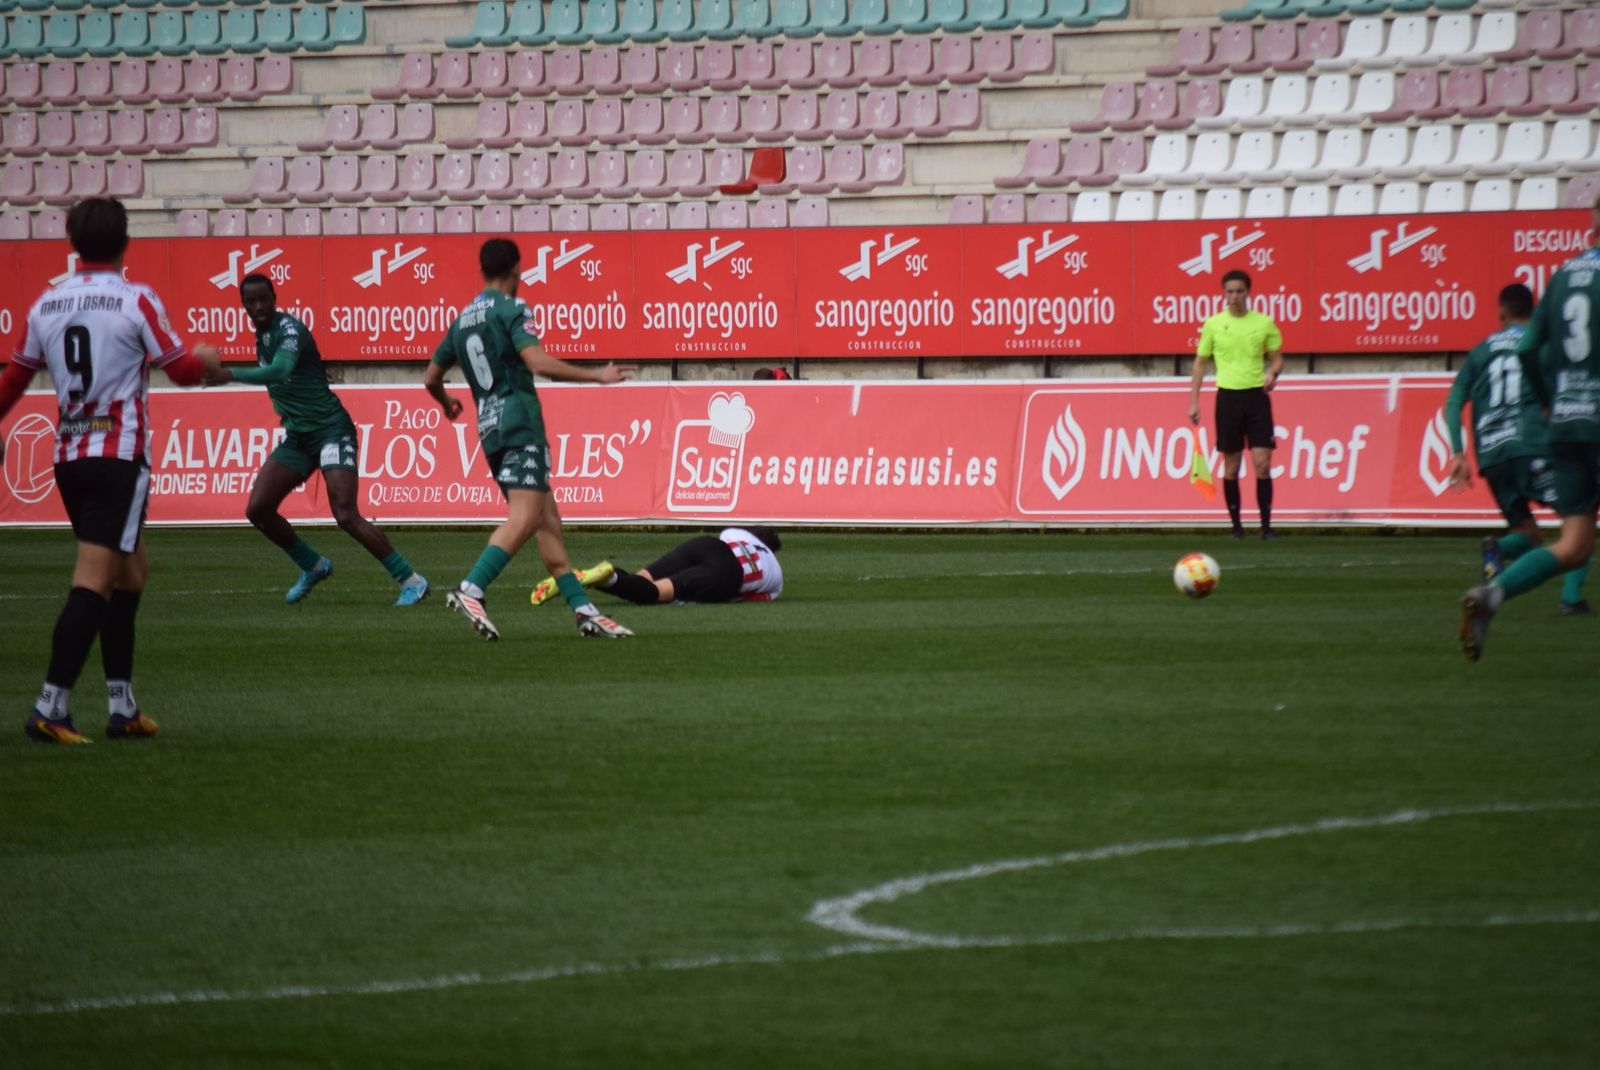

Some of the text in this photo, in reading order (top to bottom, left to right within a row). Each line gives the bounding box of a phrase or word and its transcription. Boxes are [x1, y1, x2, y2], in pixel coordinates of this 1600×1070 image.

[1064, 250, 1088, 275] sgc
[1249, 246, 1274, 271] sgc
[1420, 243, 1447, 268] sgc
[1513, 228, 1595, 253] DESGUAC
[270, 262, 291, 286] sgc
[413, 261, 435, 285] sgc
[580, 258, 602, 282] sgc
[730, 256, 753, 279] sgc
[905, 252, 928, 277] sgc
[187, 298, 315, 342] sangreio
[330, 297, 459, 342] sangregorio
[533, 295, 626, 340] gregorio
[642, 293, 778, 339] sangregorio
[815, 290, 954, 337] sangregorio
[971, 288, 1115, 336] sangregorio
[1152, 285, 1302, 334] sangrorio
[1320, 282, 1476, 331] sangregorio
[1563, 293, 1592, 362] 3
[64, 325, 94, 403] 9
[466, 333, 494, 391] 6
[544, 343, 596, 353] STRUCCION
[1488, 354, 1522, 408] 11
[358, 421, 437, 479] LOS
[677, 446, 737, 489] Susi
[748, 447, 998, 495] casqueriasusi.es
[149, 473, 207, 495] CIONES
[423, 486, 443, 503] DE
[446, 482, 493, 505] OVEJA
